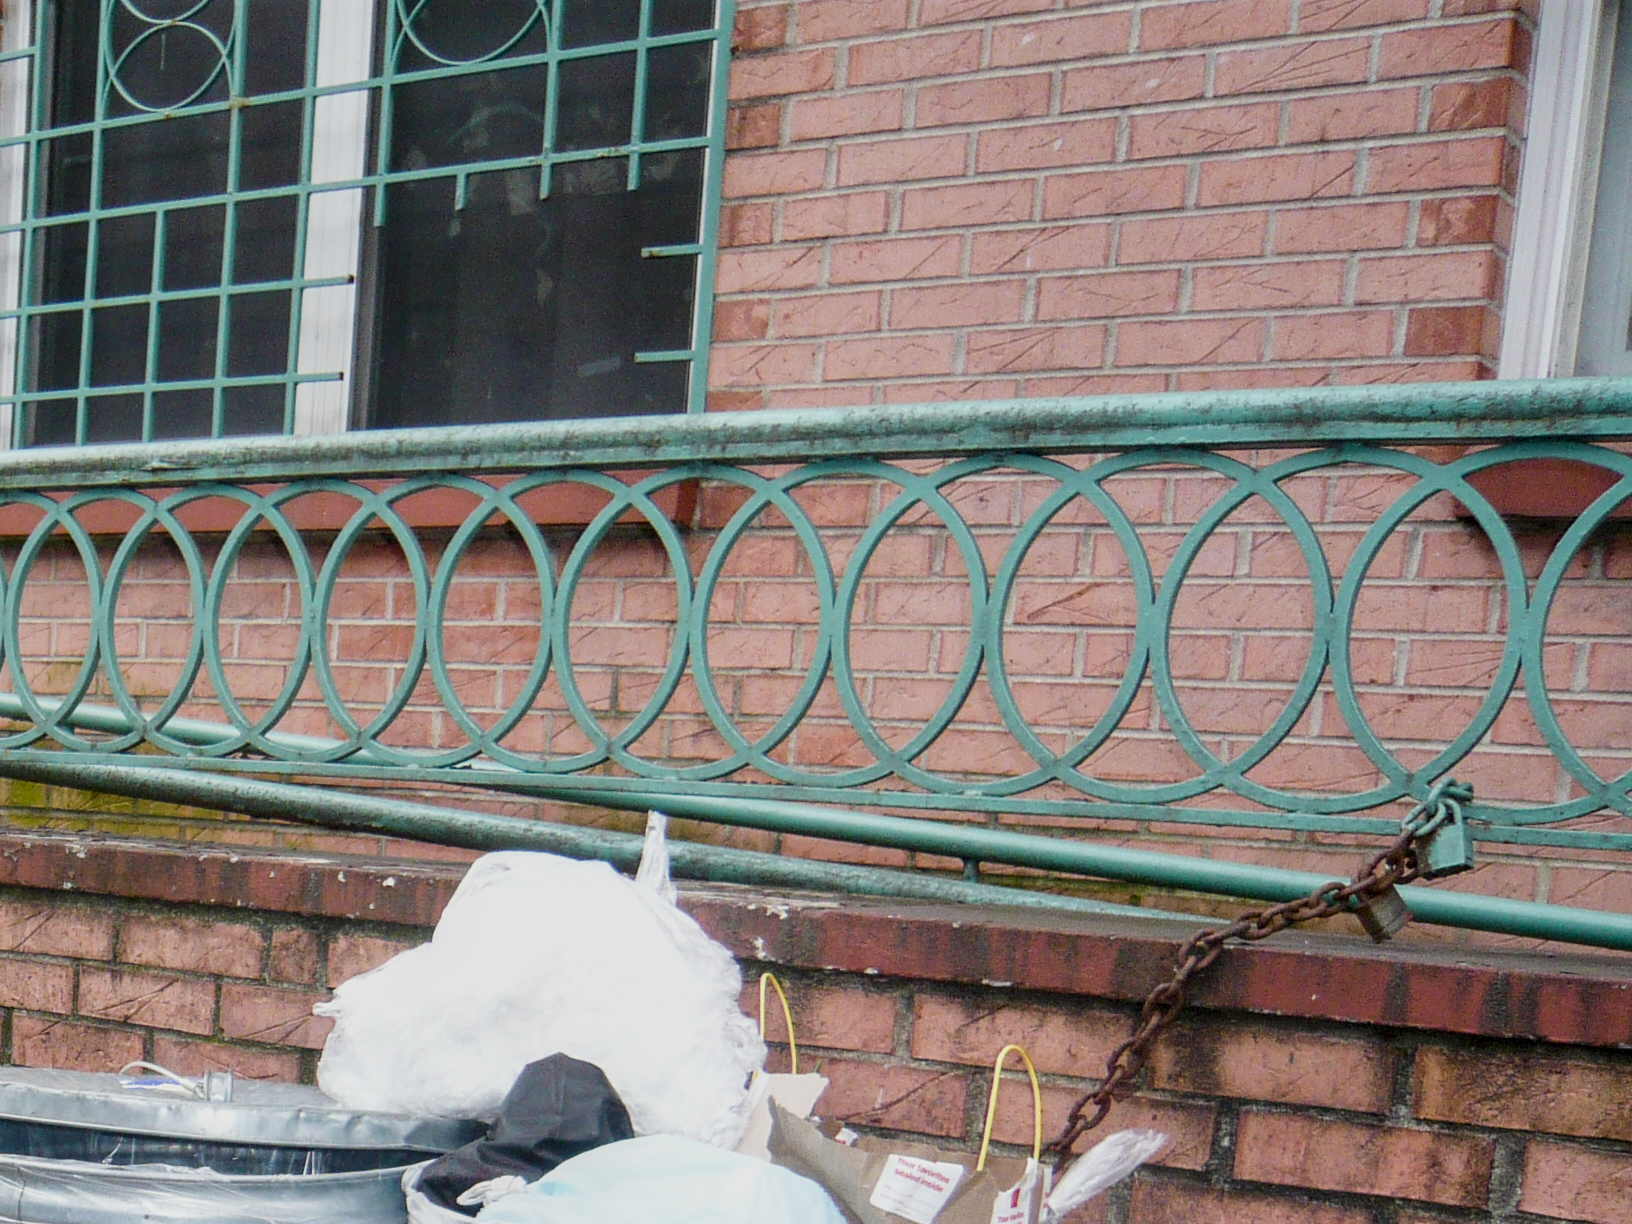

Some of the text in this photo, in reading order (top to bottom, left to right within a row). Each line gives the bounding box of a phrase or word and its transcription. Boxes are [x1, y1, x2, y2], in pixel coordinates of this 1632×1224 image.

[894, 1168, 944, 1193] sealed inside
[898, 1155, 950, 1184] Your favorites
